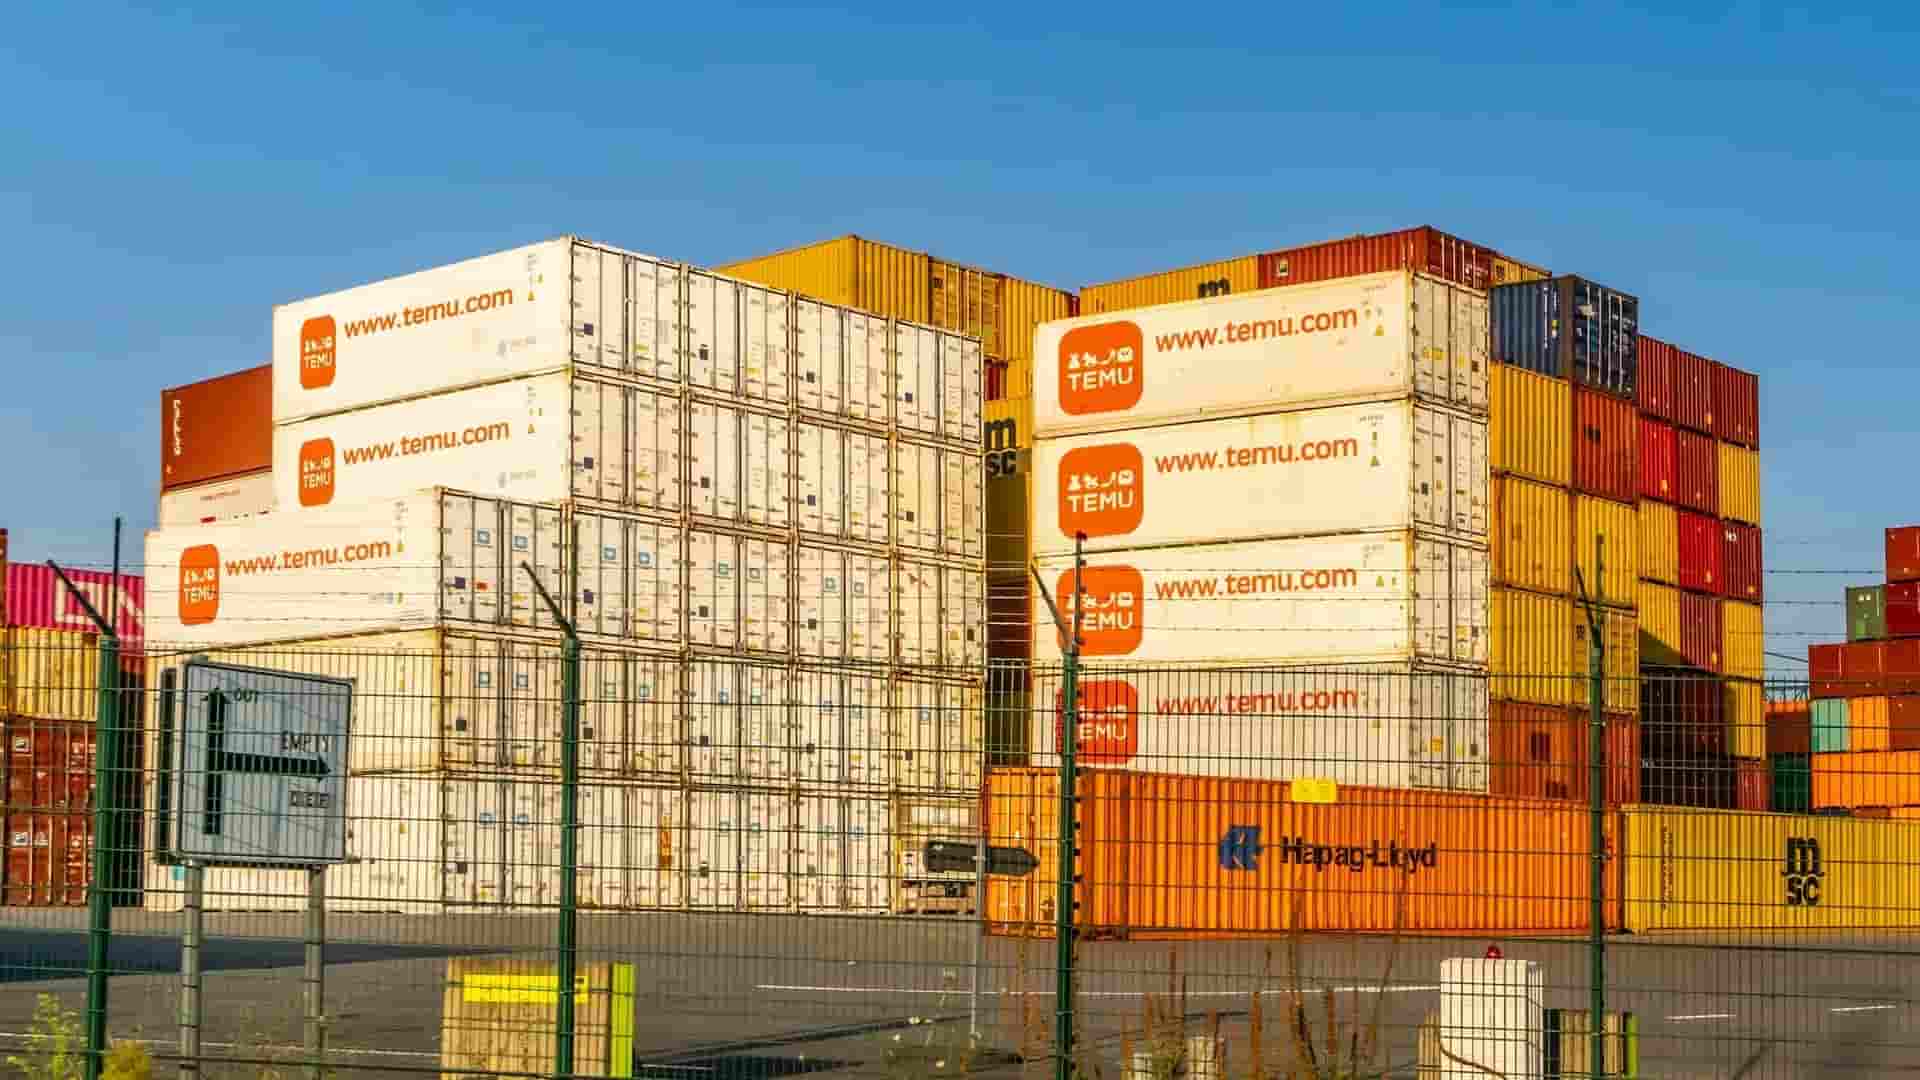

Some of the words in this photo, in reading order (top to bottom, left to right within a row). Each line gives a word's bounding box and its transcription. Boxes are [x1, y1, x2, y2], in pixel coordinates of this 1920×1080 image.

[344, 288, 513, 338] www.temu.com
[1155, 306, 1359, 353] www.temu.com
[304, 350, 333, 369] TEMU
[1067, 366, 1134, 391] TEMU
[343, 421, 510, 465] www.temu.com
[1154, 437, 1359, 473] www.temu.com
[303, 470, 332, 489] TEMU
[1067, 489, 1134, 513] TEMU
[224, 539, 391, 576] www.temu.com
[184, 583, 216, 605] TEMU
[1155, 567, 1358, 600] www.temu.com
[1155, 687, 1359, 718] www.temu.com
[1078, 723, 1127, 741] EMU
[1280, 836, 1436, 874] Hapag-Lloyd
